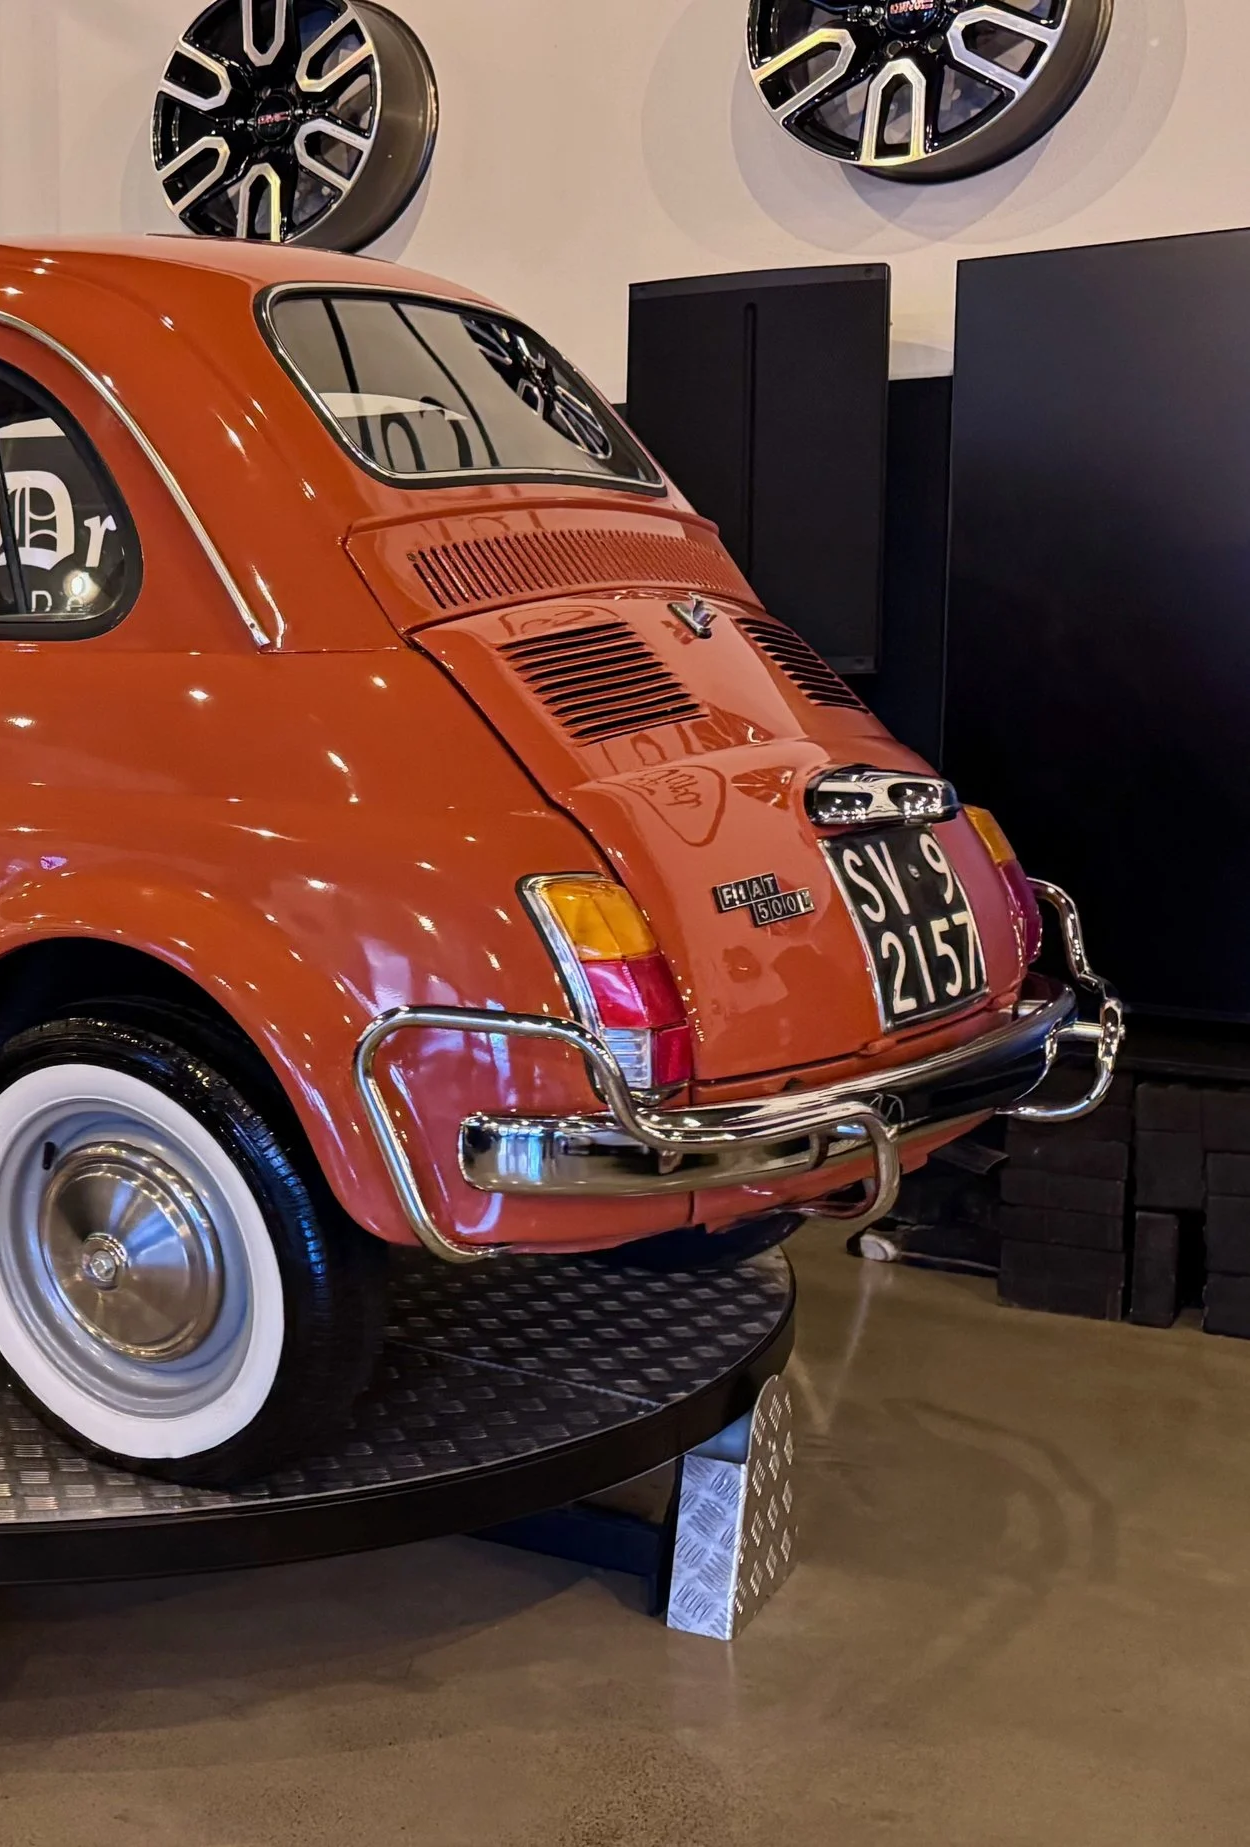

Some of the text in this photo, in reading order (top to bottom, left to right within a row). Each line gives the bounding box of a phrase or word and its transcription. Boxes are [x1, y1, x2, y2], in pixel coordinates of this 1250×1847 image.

[721, 876, 774, 905] FIAT
[842, 833, 954, 923] SV 9
[881, 910, 978, 1014] 2157
